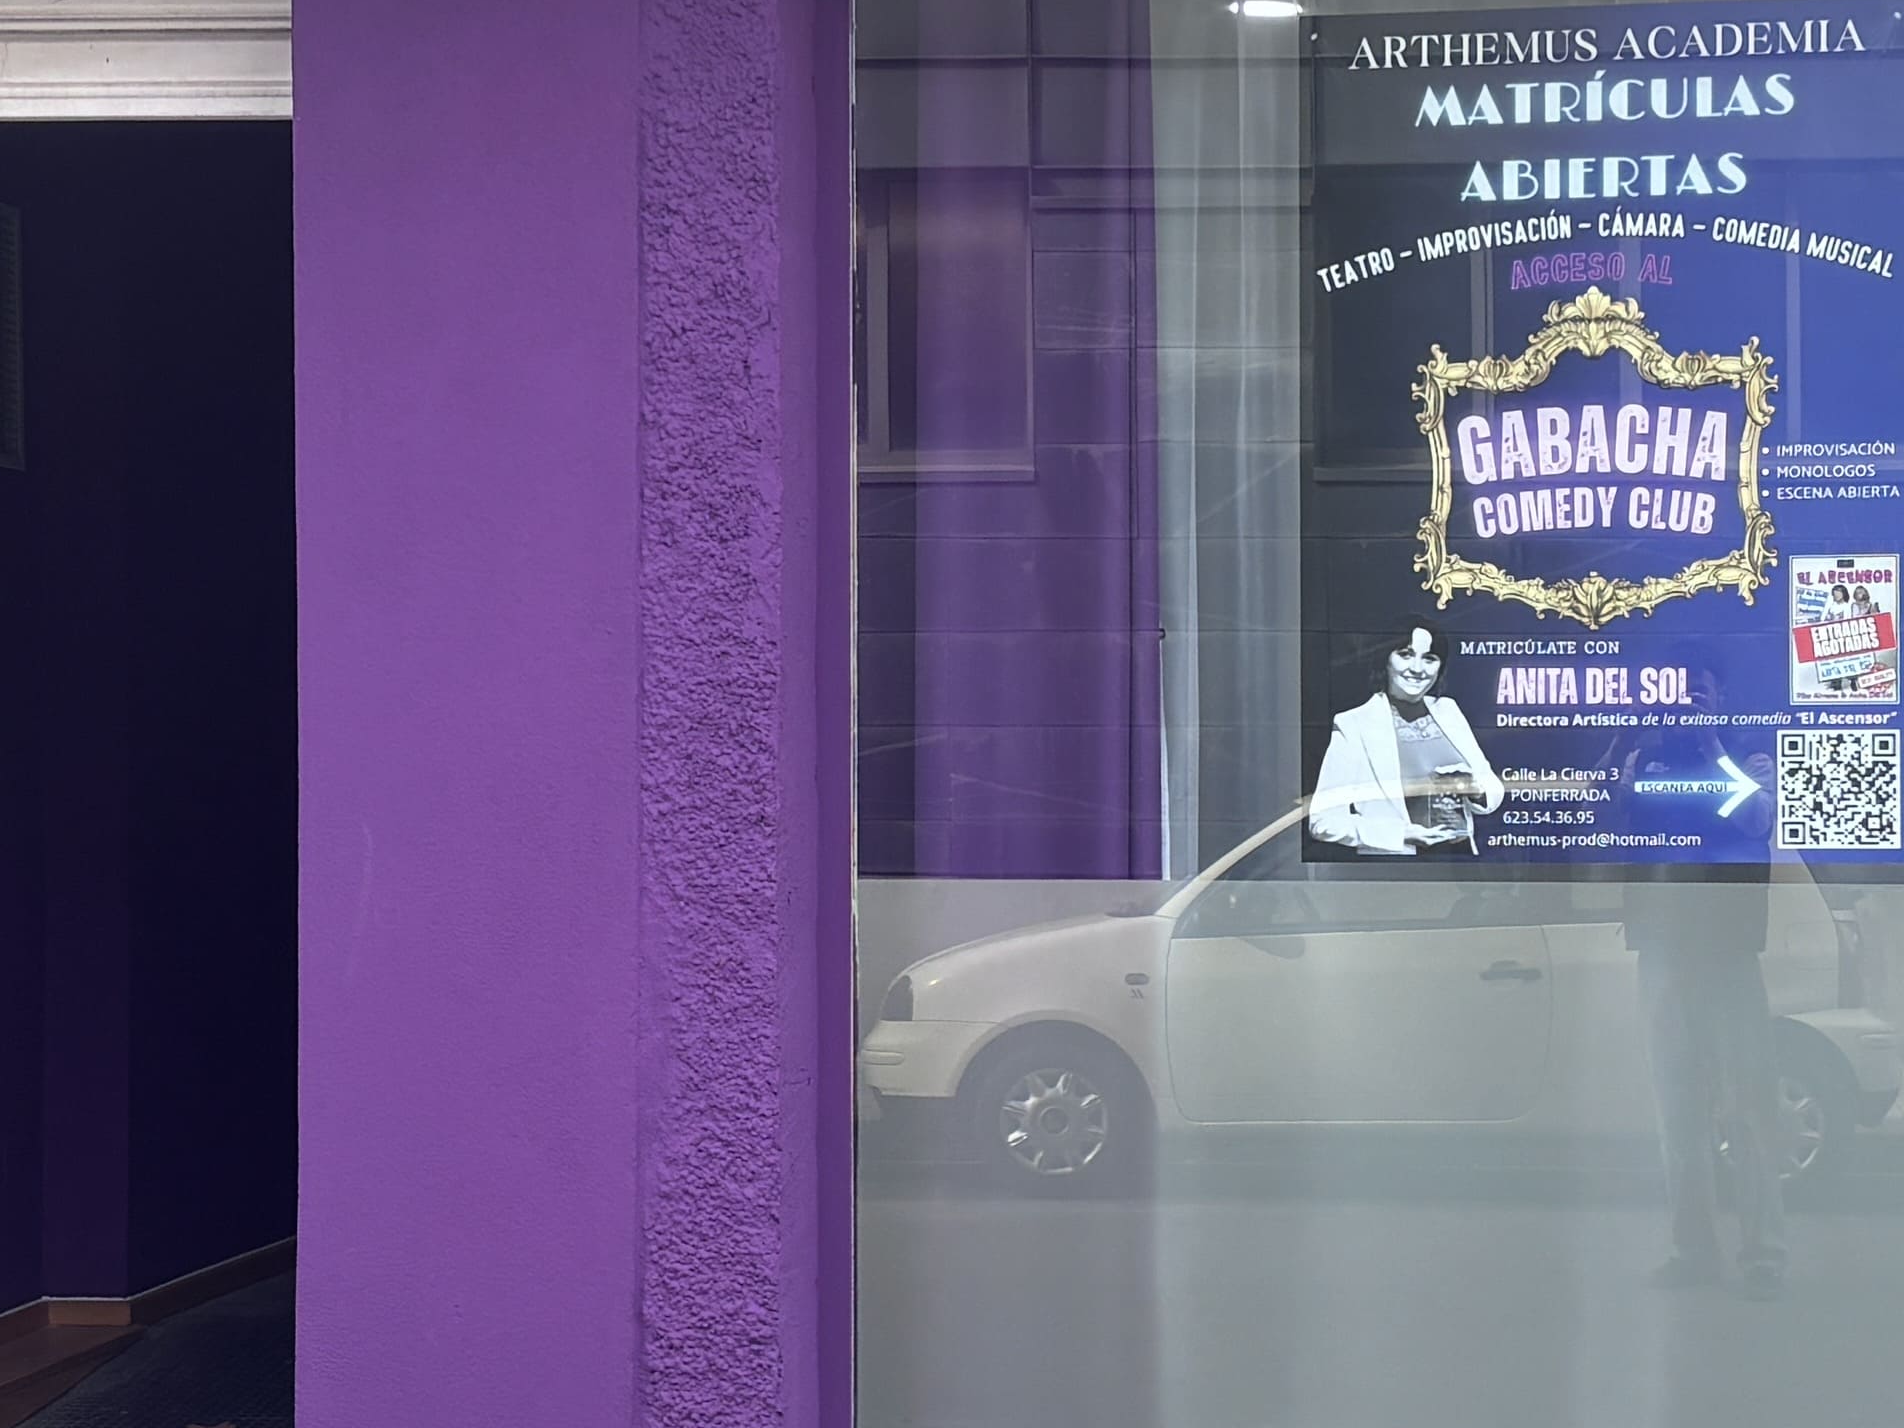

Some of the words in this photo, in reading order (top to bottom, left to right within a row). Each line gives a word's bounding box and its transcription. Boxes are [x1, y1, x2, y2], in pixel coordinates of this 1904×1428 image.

[1348, 28, 1598, 70] ARTHEMUS
[1612, 19, 1866, 61] ACADEMIA
[1414, 69, 1794, 127] MATRÍCULAS
[1460, 152, 1746, 202] ABIERTAS
[1317, 248, 1395, 292] TEATRO
[1417, 209, 1572, 262] IMPROVISACIÓN
[1598, 206, 1685, 238] CÁMARA
[1712, 216, 1800, 253] COMEDIA
[1806, 232, 1894, 278] MUSICAL
[1511, 252, 1625, 290] ACCESO
[1638, 254, 1673, 284] AL
[1457, 404, 1728, 485] GABACHA
[1777, 440, 1895, 457] IMPROVISACIÓN
[1777, 464, 1876, 478] MONOLOGOS
[1777, 486, 1833, 500] ESCENA
[1837, 485, 1900, 499] ABIERTA
[1473, 486, 1618, 539] COMEDY
[1629, 486, 1716, 535] CLUB
[1811, 617, 1876, 641] ENTRADAS
[1460, 638, 1577, 655] MATRICÚLATE
[1584, 641, 1620, 654] CON
[1814, 633, 1880, 658] AGOTADAS
[1496, 667, 1578, 705] ANITA
[1585, 667, 1633, 705] DEL
[1640, 667, 1692, 705] SOL
[1497, 714, 1569, 727] Directora
[1572, 713, 1638, 726] Artística
[1642, 712, 1659, 725] de
[1662, 712, 1676, 725] la
[1680, 712, 1728, 726] exitosa
[1731, 711, 1792, 726] comedia
[1502, 768, 1537, 781] Calle
[1540, 768, 1557, 781] La
[1561, 768, 1606, 781] Cierva
[1609, 768, 1620, 781] 3
[1511, 788, 1611, 802] PONFERRADA
[1502, 811, 1595, 824] 623.54.36.95
[1487, 832, 1701, 849] arthemus-prod@hotmail.com
